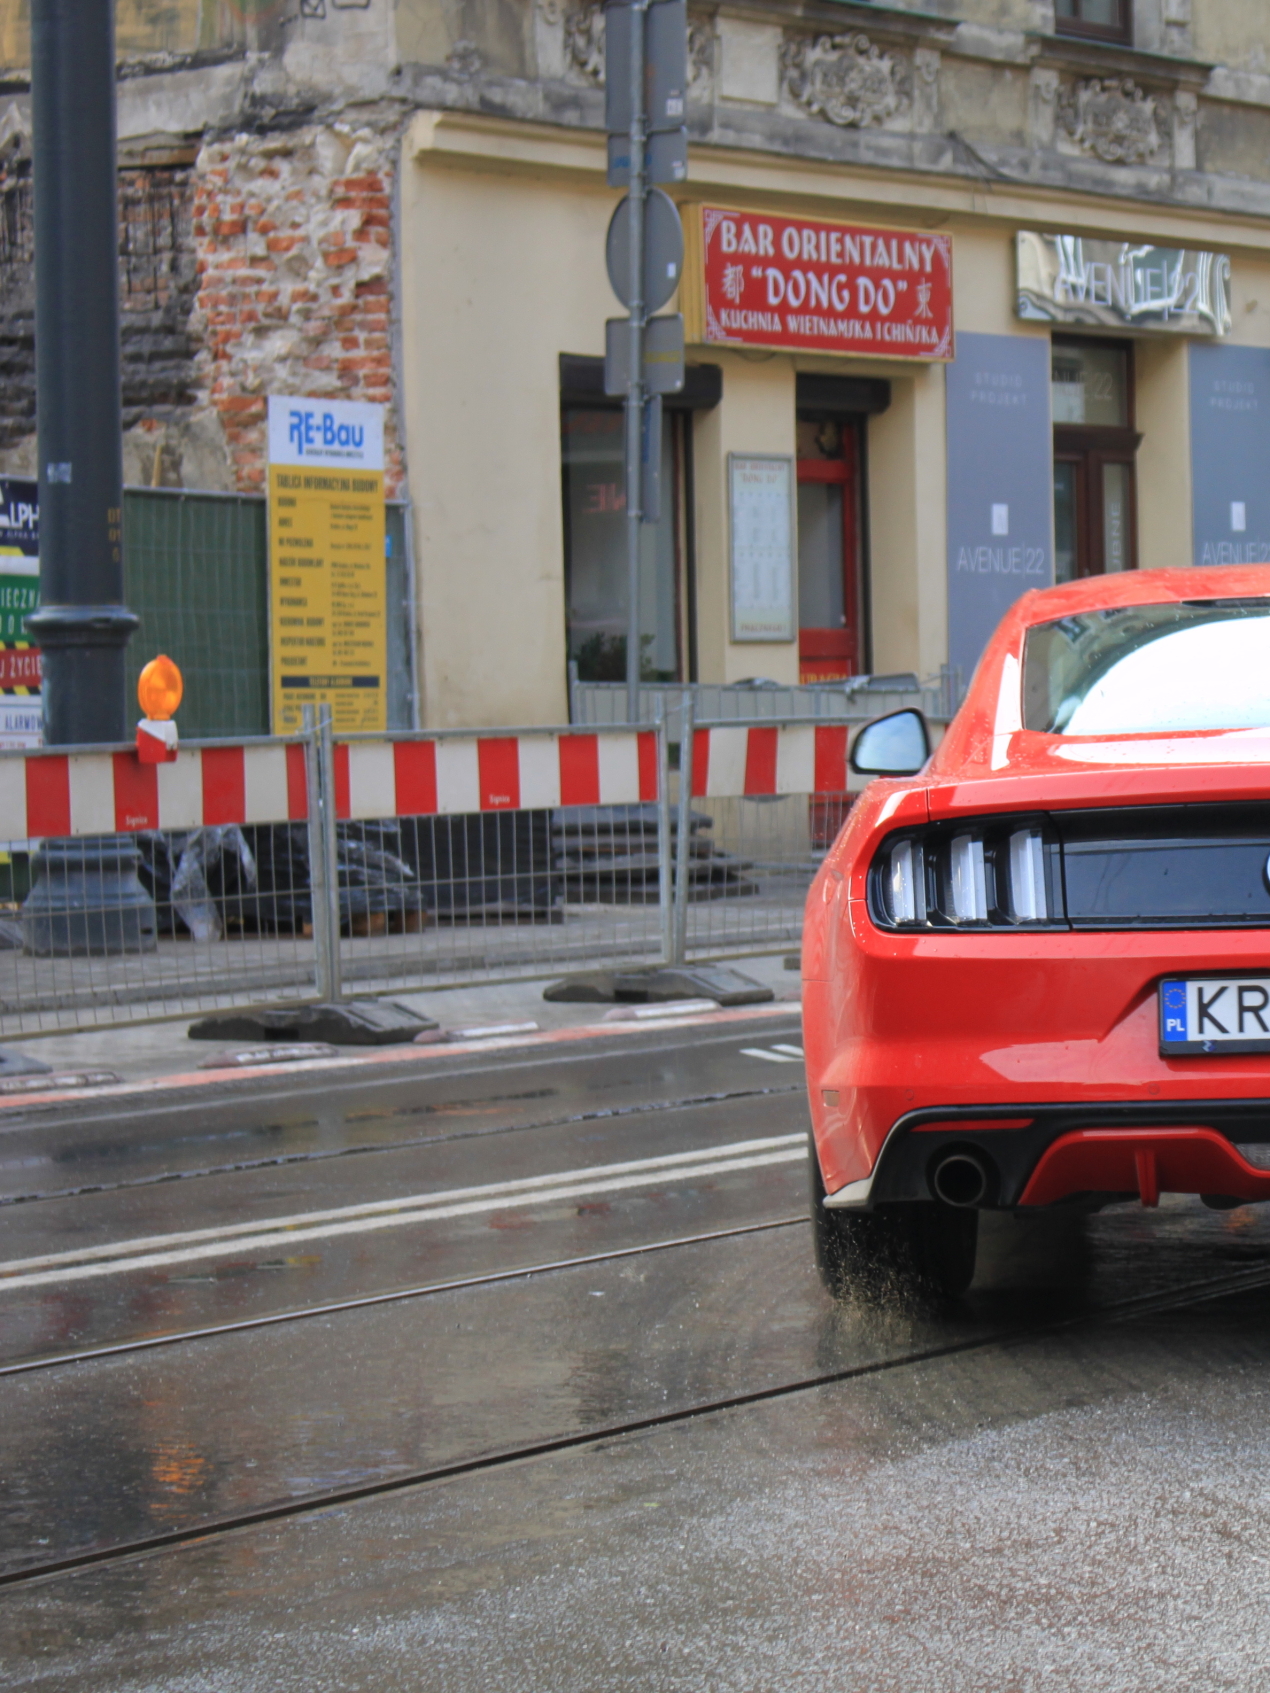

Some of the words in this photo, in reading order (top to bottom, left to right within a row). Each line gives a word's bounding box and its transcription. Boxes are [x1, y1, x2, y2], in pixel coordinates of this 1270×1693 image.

[721, 220, 775, 257] BAR
[781, 227, 935, 272] ORIENTALNY
[720, 308, 782, 333] KUCHNIA
[787, 314, 873, 339] WIETNAMSKA
[875, 321, 882, 341] I
[883, 319, 939, 344] CHIŃSKA
[975, 371, 1023, 388] STUDIO
[970, 390, 1027, 405] PROJEKT
[289, 410, 364, 455] RE-Bau
[277, 473, 302, 489] TABLICA
[304, 475, 350, 492] INFORMACYJNA
[1196, 984, 1270, 1034] KR
[1166, 1018, 1186, 1033] PL
